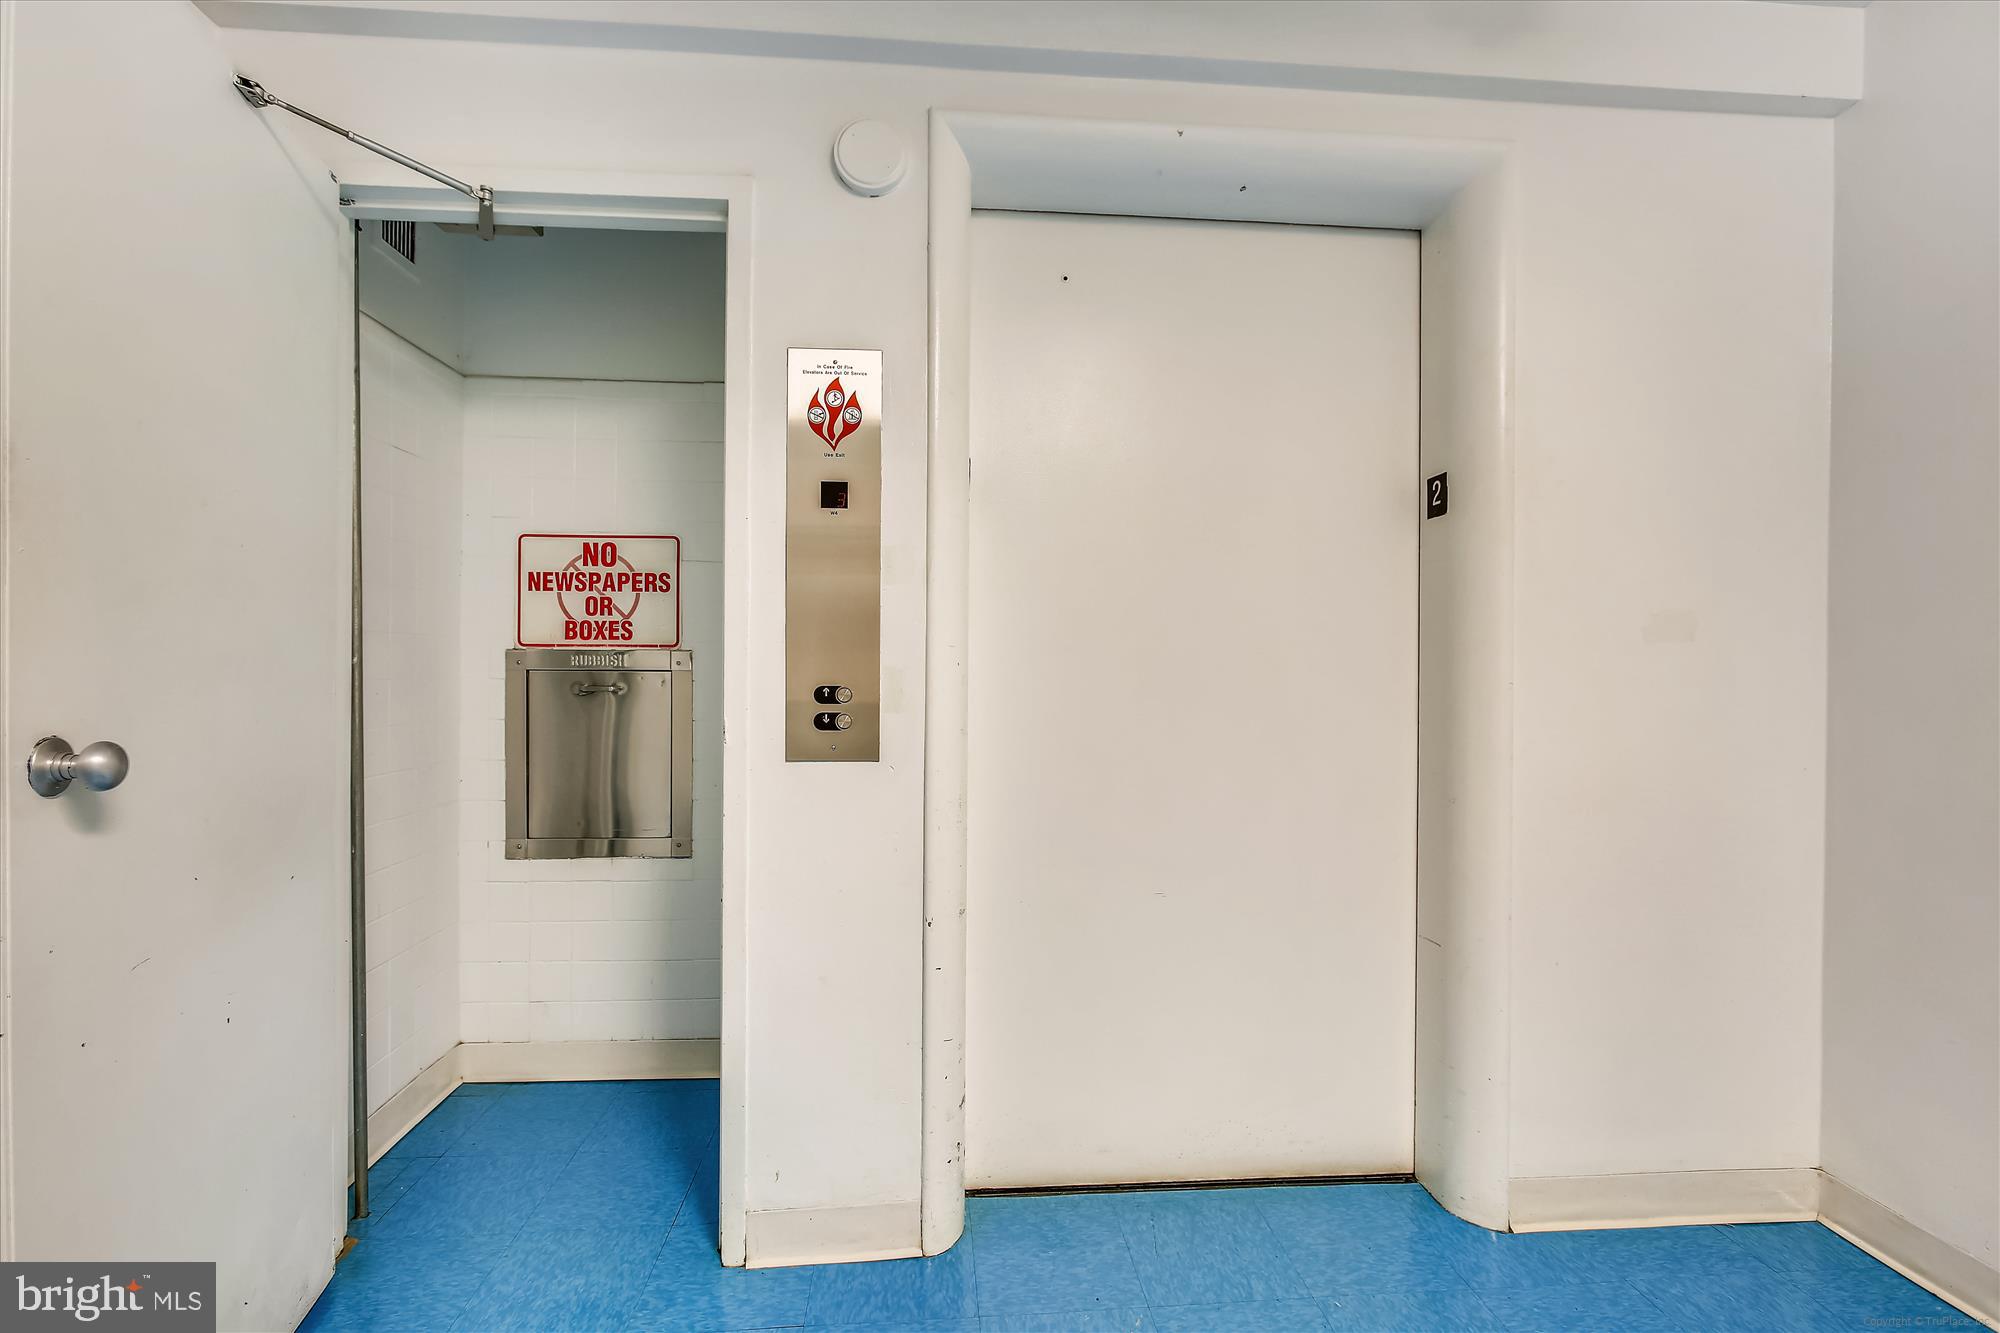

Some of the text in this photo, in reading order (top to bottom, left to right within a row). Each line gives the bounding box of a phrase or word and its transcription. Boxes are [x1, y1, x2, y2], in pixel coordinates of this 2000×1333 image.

[1432, 480, 1441, 506] 2
[582, 541, 617, 567] NO
[527, 571, 671, 592] NEWSPAPERS
[584, 596, 613, 616] OR
[564, 619, 633, 640] BOXES
